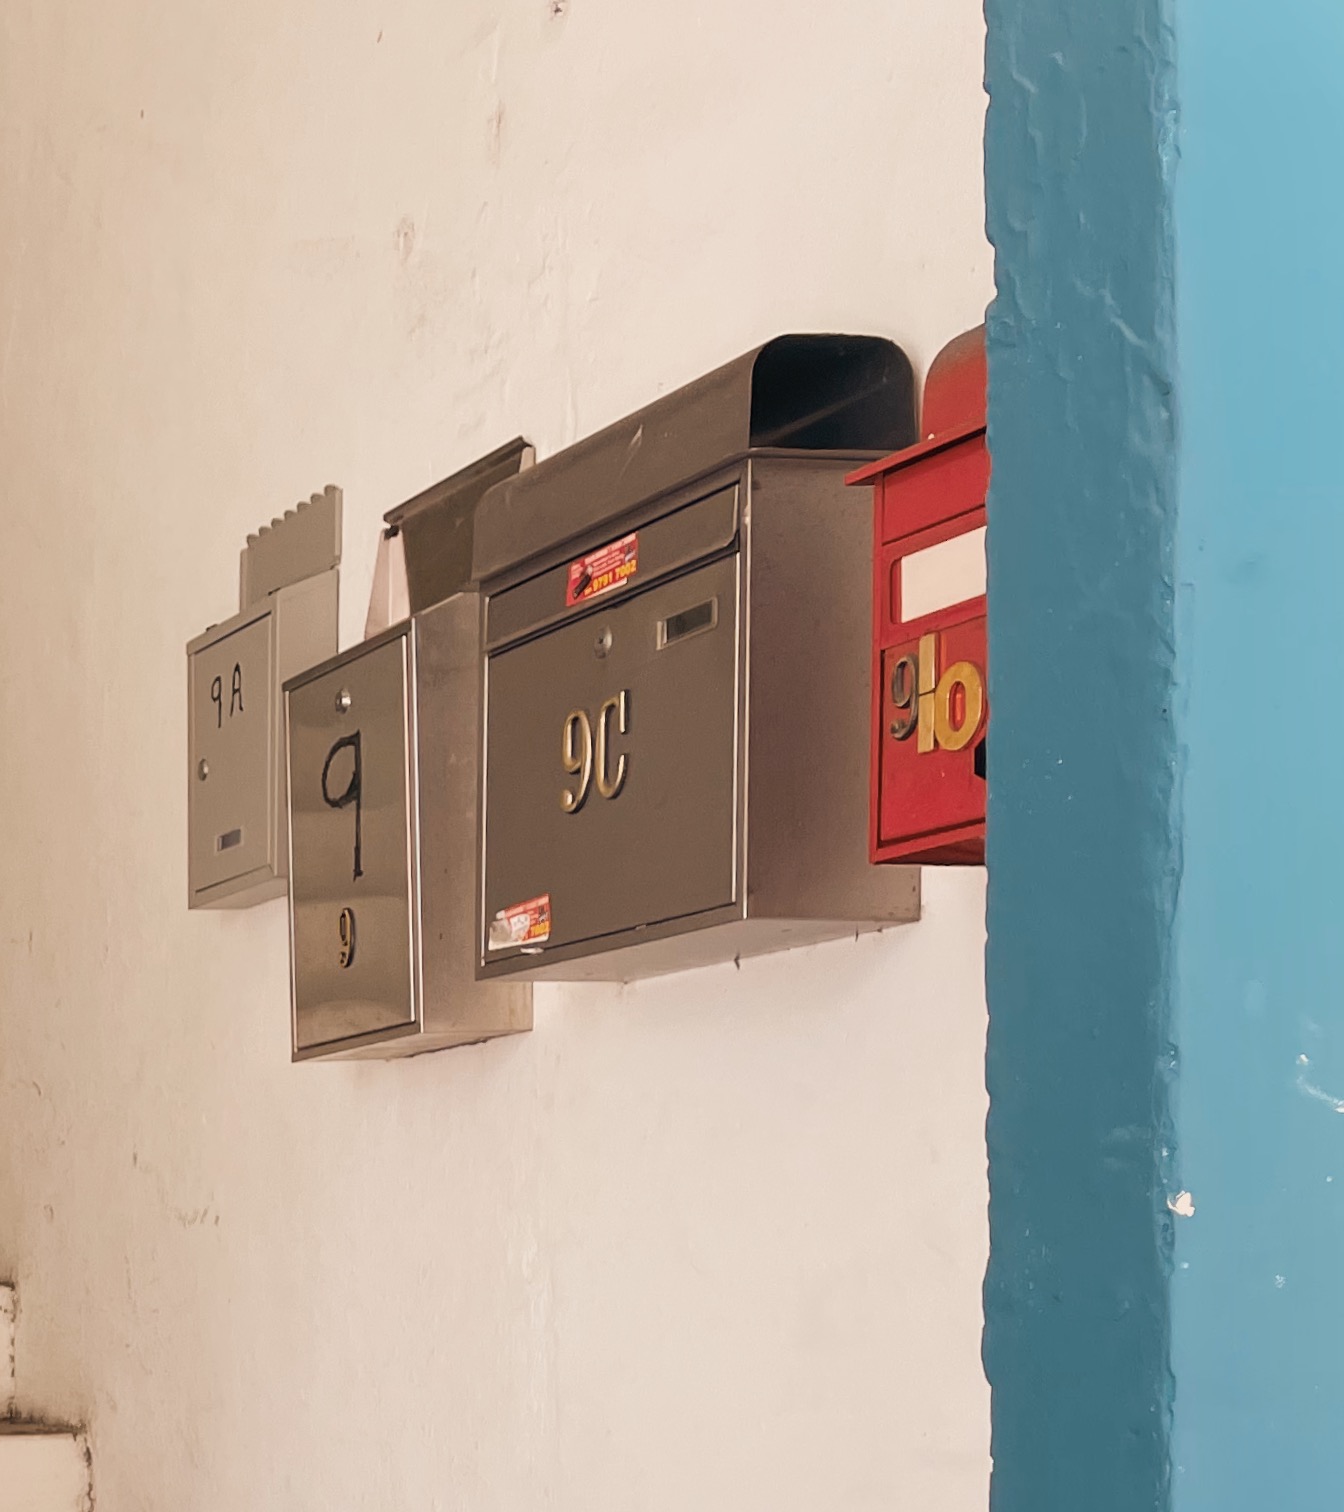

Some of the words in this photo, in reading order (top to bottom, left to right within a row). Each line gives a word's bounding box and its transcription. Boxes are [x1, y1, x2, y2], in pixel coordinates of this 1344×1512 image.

[321, 728, 364, 882] 9
[560, 689, 629, 814] 9C
[338, 906, 355, 969] 9
